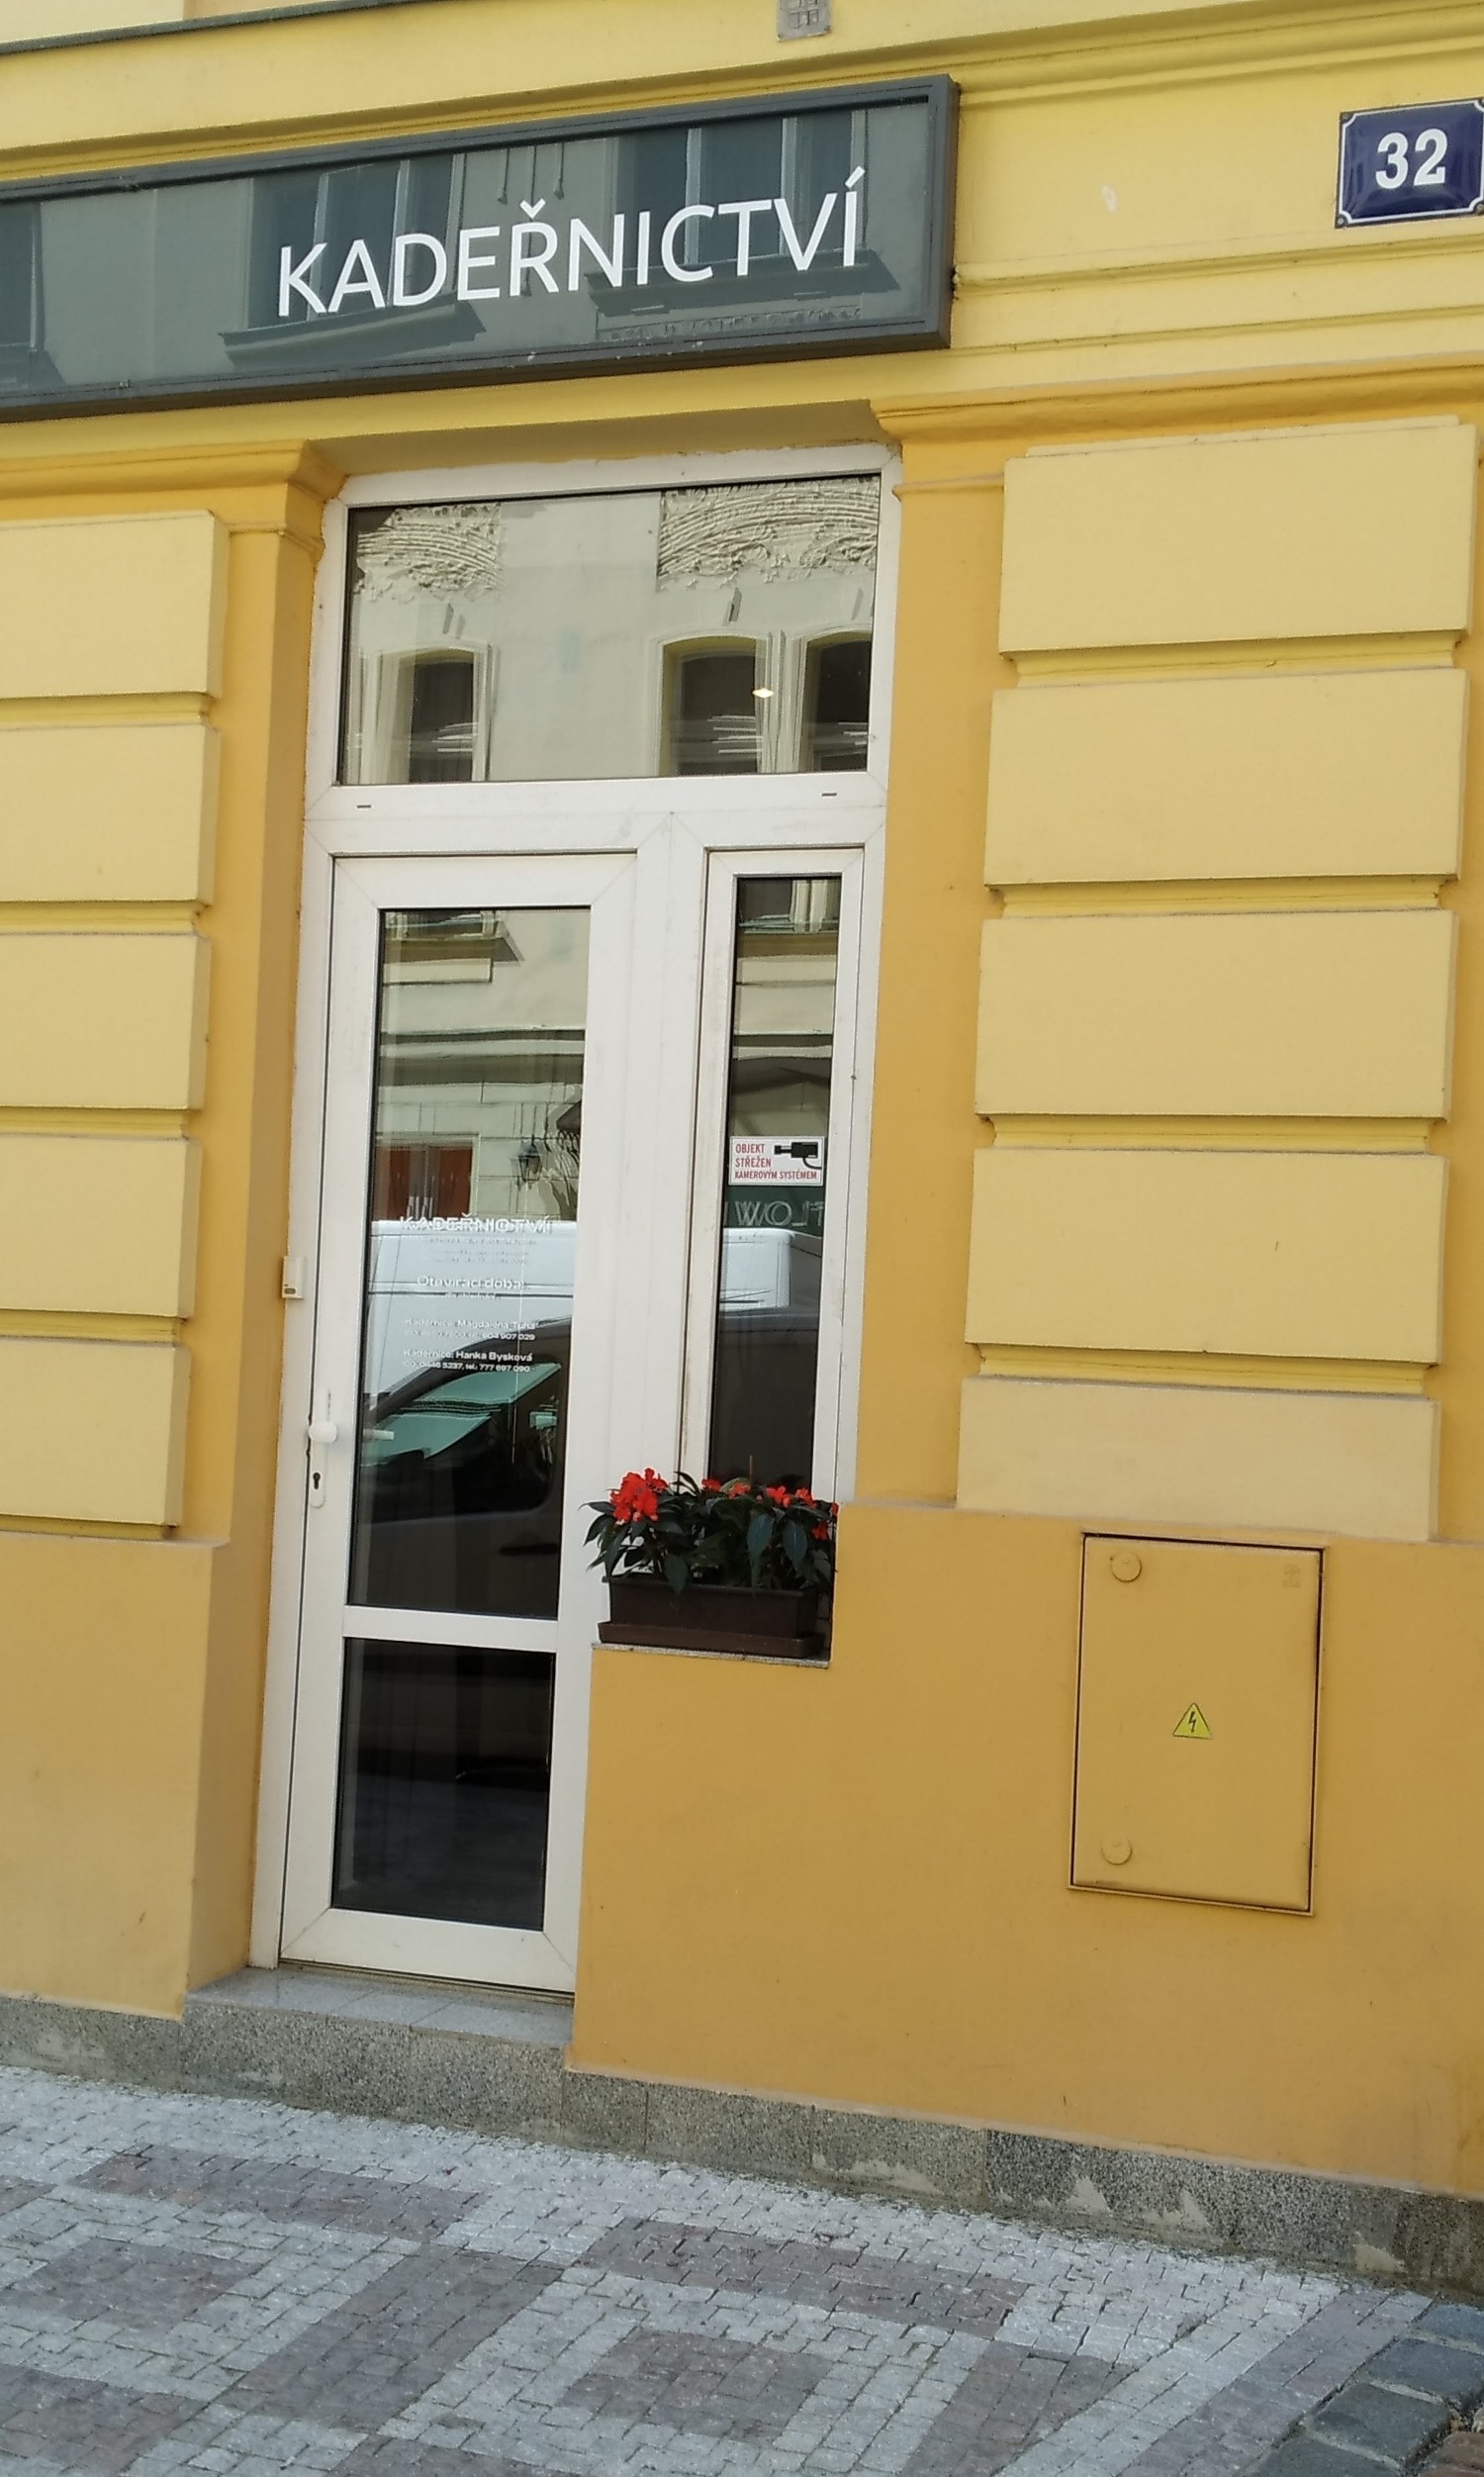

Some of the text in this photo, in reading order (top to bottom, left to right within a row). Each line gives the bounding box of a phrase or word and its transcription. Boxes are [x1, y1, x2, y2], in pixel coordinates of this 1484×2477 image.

[1375, 128, 1447, 189] 32
[278, 165, 866, 318] KADEŘNICTVÍ
[735, 1143, 766, 1154] OBJEKT
[735, 1156, 772, 1168] STŘEŽEN
[735, 1169, 817, 1180] KAMEROVÝM SYSTÉMEM
[400, 1212, 551, 1233] KADEŘNICTVÍ
[455, 1350, 487, 1360] Hanka
[488, 1351, 533, 1363] Bysková
